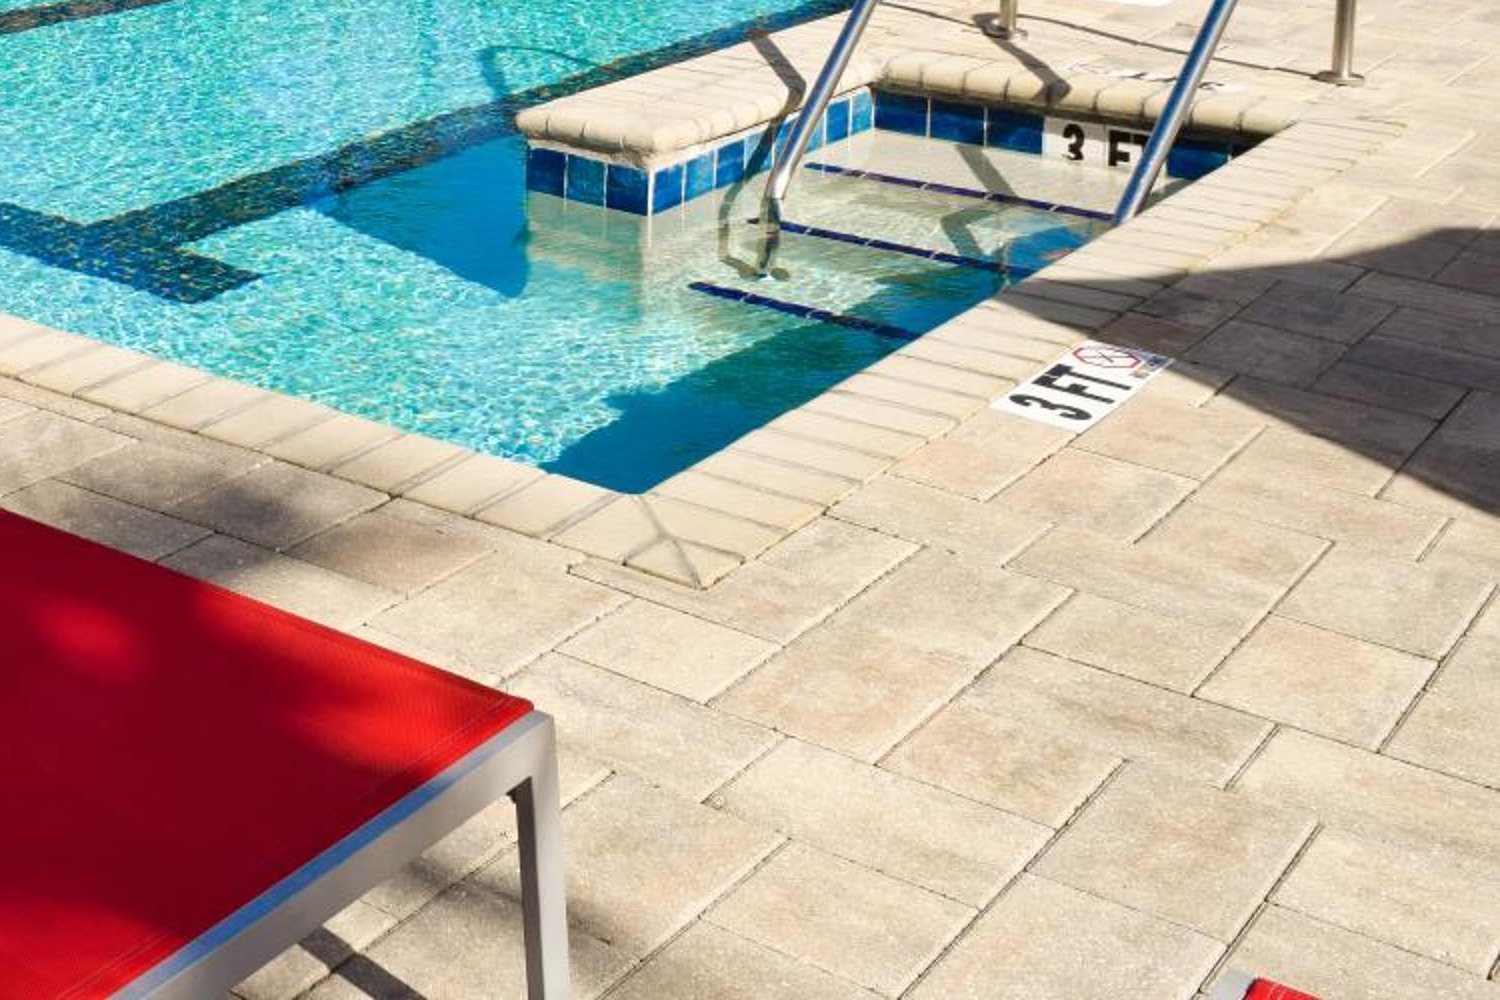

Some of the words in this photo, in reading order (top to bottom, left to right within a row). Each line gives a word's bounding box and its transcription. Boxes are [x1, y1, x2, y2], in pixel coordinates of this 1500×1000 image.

[1062, 123, 1085, 161] 3
[1032, 363, 1133, 405] FT
[1009, 393, 1092, 421] 3
